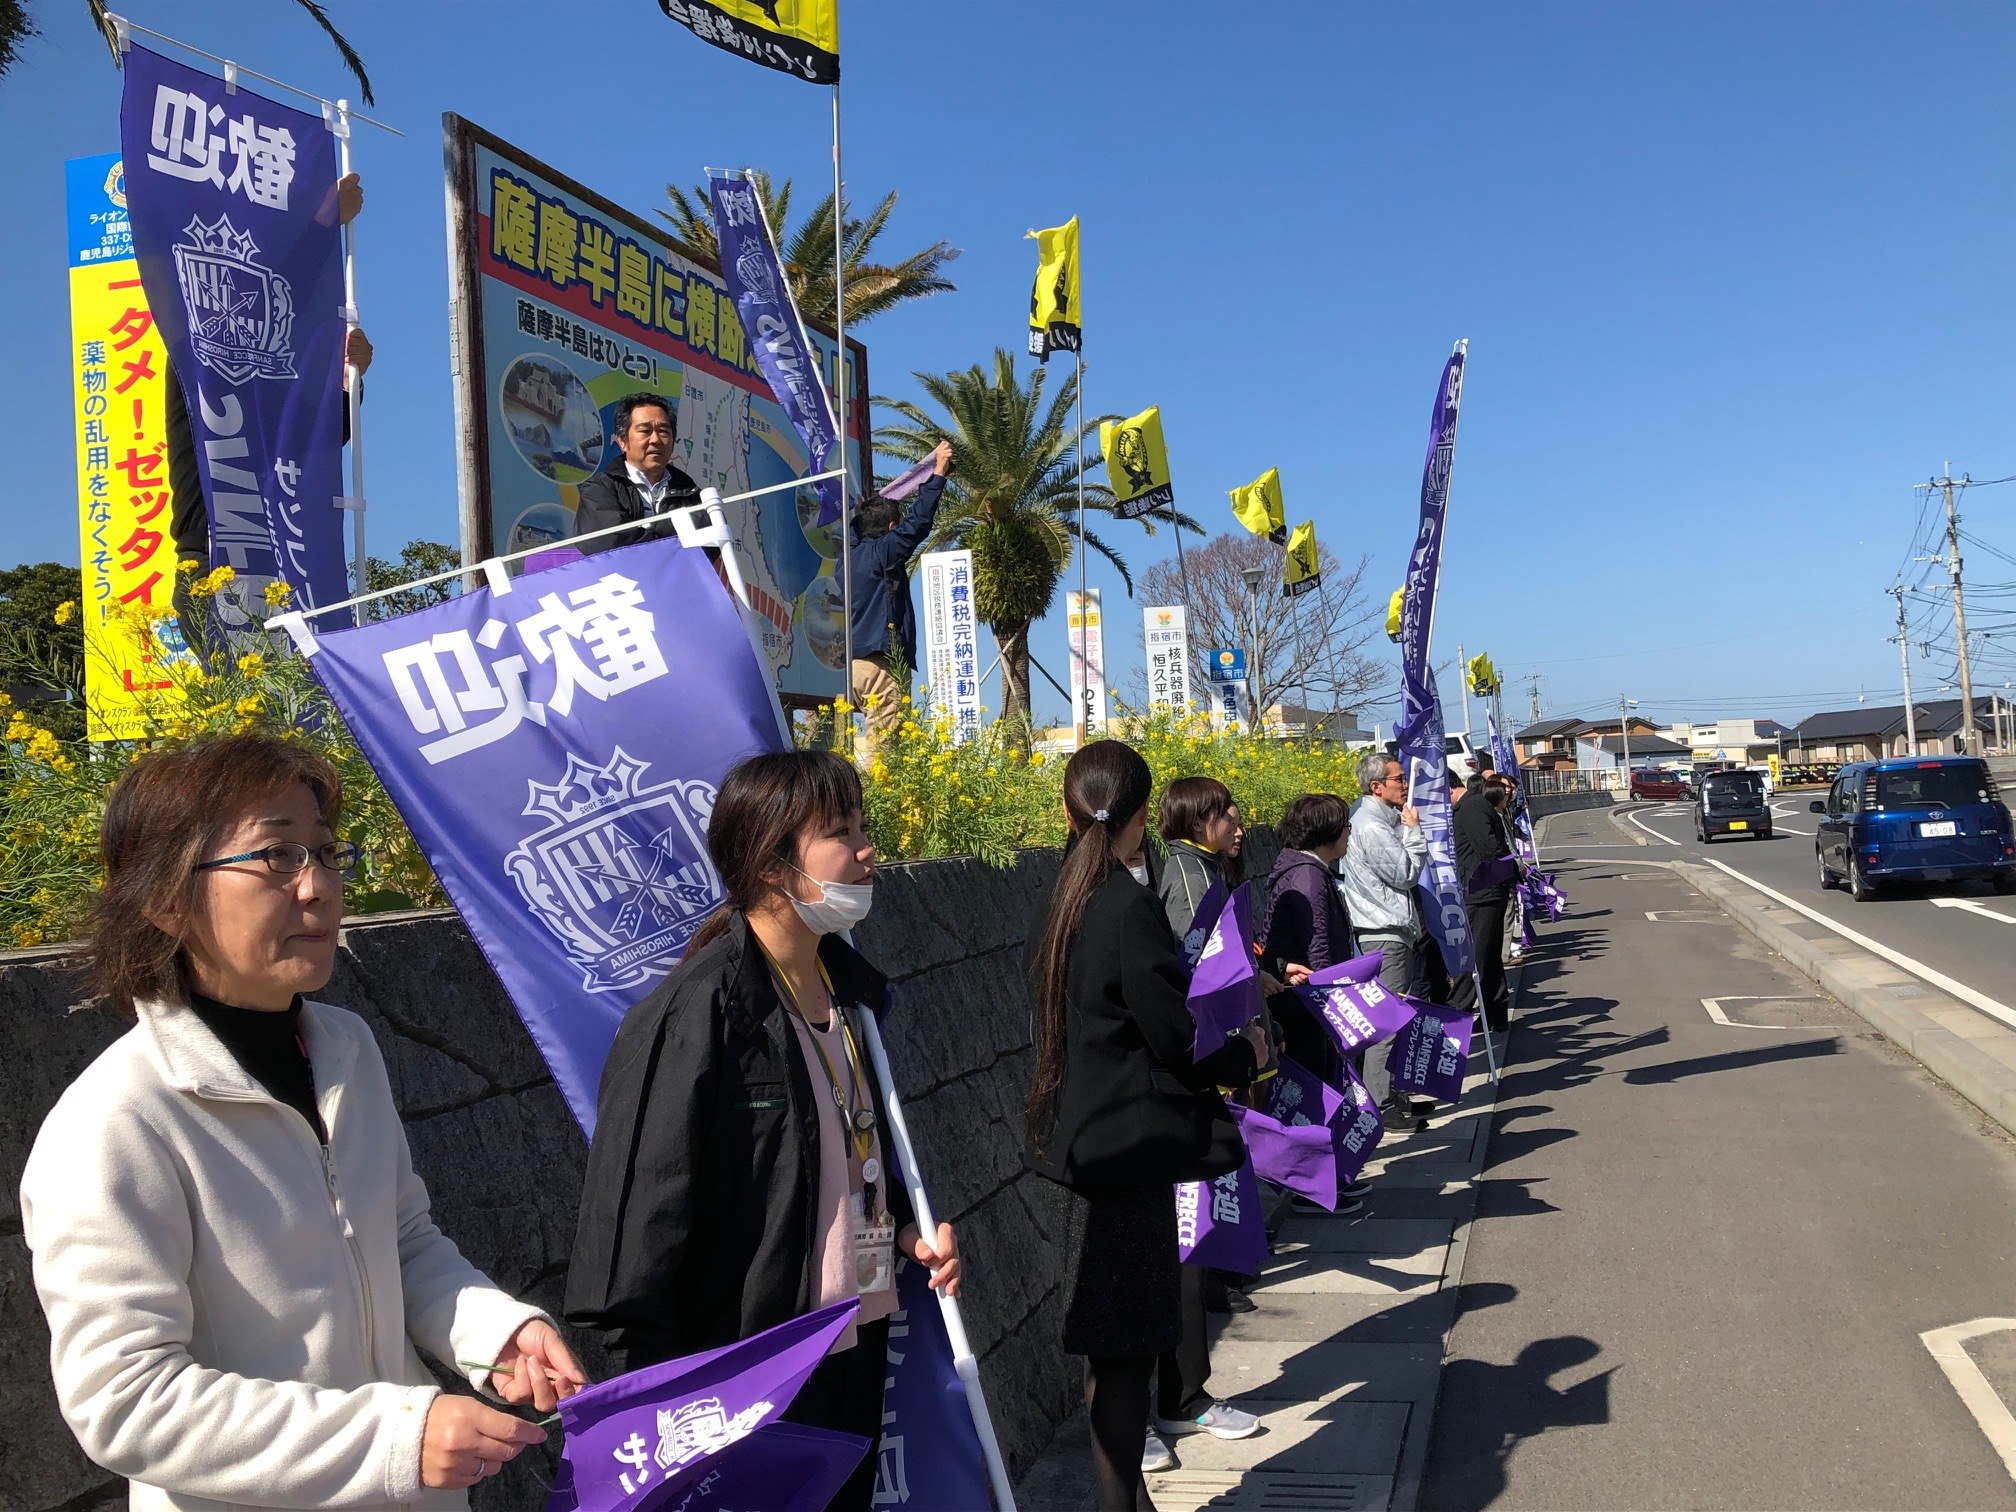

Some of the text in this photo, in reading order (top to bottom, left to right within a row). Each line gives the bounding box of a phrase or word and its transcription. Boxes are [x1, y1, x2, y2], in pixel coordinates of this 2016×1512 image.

[106, 221, 132, 235] 国際
[1150, 631, 1182, 643] 指宿市
[1414, 1036, 1435, 1086] SANFRECCE
[1437, 1036, 1462, 1077] 歓迎
[1342, 1110, 1379, 1154] 歓迎
